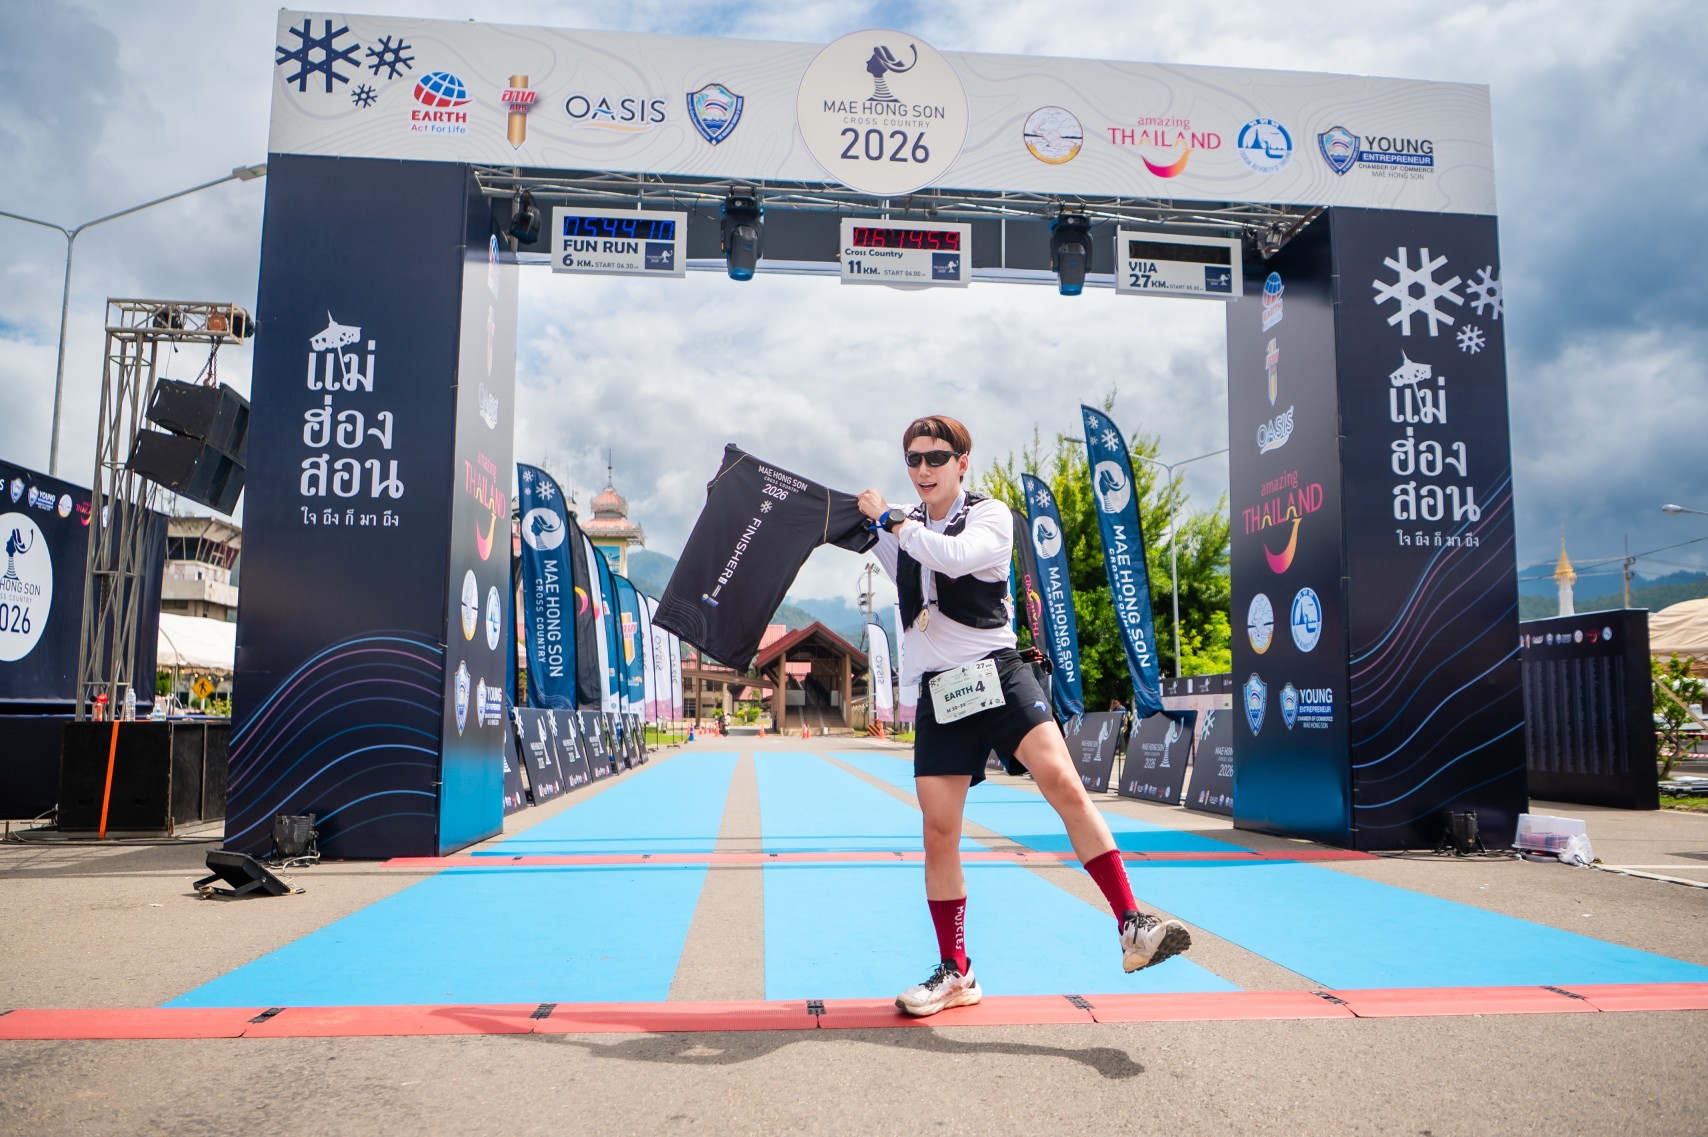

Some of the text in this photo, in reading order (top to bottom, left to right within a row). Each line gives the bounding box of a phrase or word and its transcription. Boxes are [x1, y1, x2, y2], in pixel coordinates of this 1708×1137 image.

[411, 109, 467, 123] EARTH
[566, 95, 666, 123] OASIS
[824, 100, 945, 119] MAE HONG SON
[411, 123, 466, 134] Act For Life
[843, 116, 930, 129] CROSS COUNTRY
[1138, 116, 1191, 130] amazing
[840, 127, 930, 164] 2026
[1107, 127, 1222, 150] THAILAND
[1365, 135, 1434, 154] YOUNG
[1358, 163, 1389, 171] CHAMBER
[1363, 152, 1431, 164] ENTREPRENEUR
[1371, 170, 1386, 178] MAE
[1388, 171, 1408, 179] HONG
[563, 238, 639, 255] FUN RUN
[845, 248, 904, 259] Cross Country
[562, 253, 574, 267] 6
[577, 259, 594, 268] KM.
[848, 260, 862, 274] 11
[863, 266, 881, 275] KM.
[1129, 273, 1152, 288] 27
[1151, 280, 1169, 289] KM.
[307, 339, 376, 392] แม่
[1389, 376, 1447, 424] แม่
[303, 394, 394, 450] ฮ่อง
[1257, 409, 1294, 448] OASIS
[1391, 426, 1468, 477] ฮ่อง
[300, 453, 405, 499] สอน
[758, 464, 808, 492] MAE HONG SON
[763, 475, 800, 494] CROSS COUNTRY
[1261, 469, 1299, 497] amazing
[762, 483, 789, 501] 2026
[1392, 480, 1481, 522] สอน
[301, 506, 399, 527] ใจ ถึง ก็ มา ถึง
[1242, 483, 1324, 535] THAILAND
[719, 517, 762, 580] FINISHER
[1396, 529, 1411, 546] ใจ
[1446, 535, 1461, 547] มา
[1109, 548, 1121, 589] CROSS
[0, 578, 41, 597] HONG SON
[1112, 525, 1152, 668] MAE HONG SON
[535, 578, 547, 663] CROSS COUNTRY
[543, 559, 564, 677] MAE HONG SON
[1048, 566, 1076, 683] MAE HONG SON
[975, 662, 985, 670] 27
[944, 685, 974, 702] EARTH
[974, 680, 986, 693] 4
[1299, 687, 1333, 704] YOUNG
[1299, 705, 1332, 713] ENTREPRENEUR
[954, 905, 965, 950] MUSCLES
